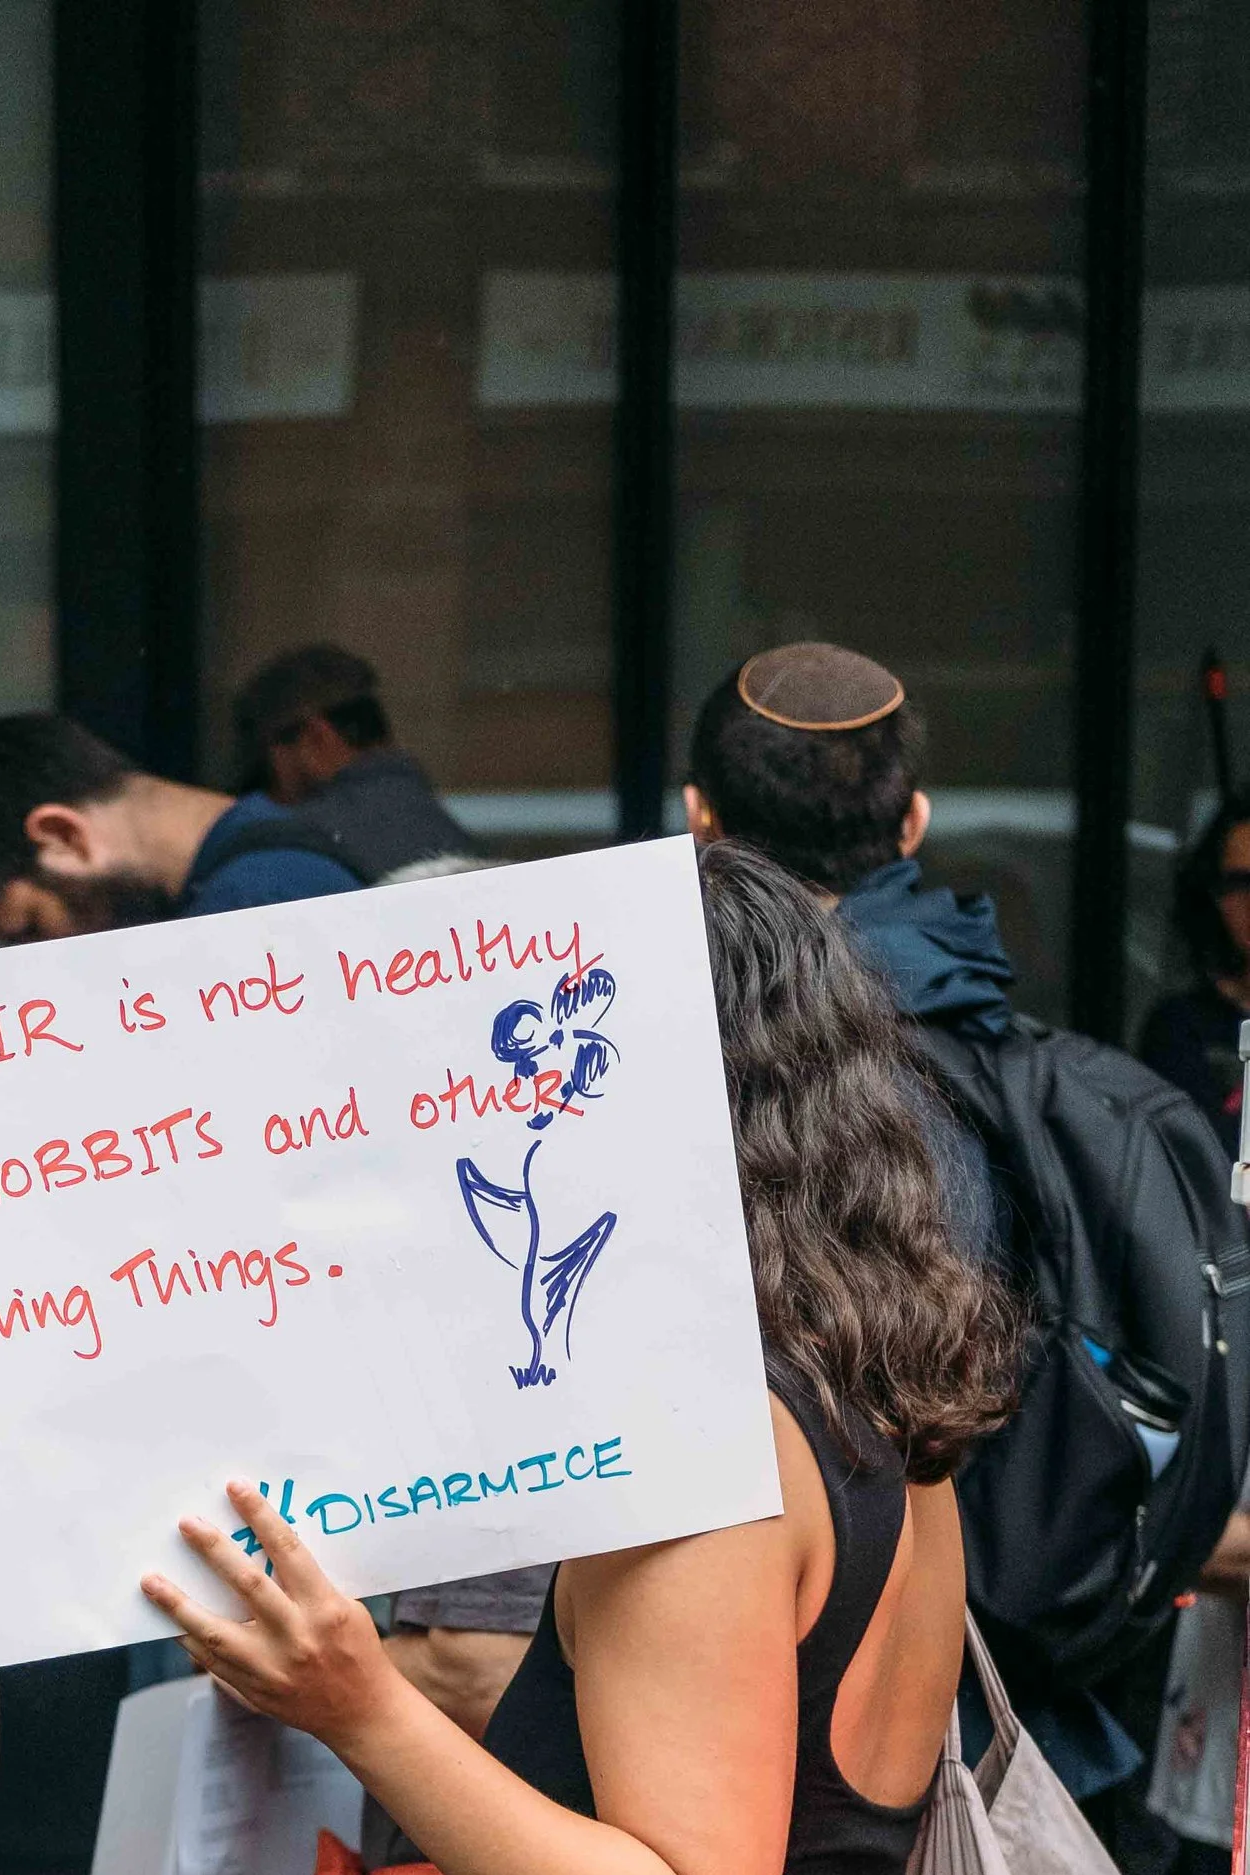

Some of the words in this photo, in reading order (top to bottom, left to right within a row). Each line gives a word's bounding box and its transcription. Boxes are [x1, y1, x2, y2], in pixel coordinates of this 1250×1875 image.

[119, 977, 167, 1034] is
[199, 952, 304, 1022] not
[338, 918, 605, 1001] healthy
[264, 1088, 368, 1155] and
[109, 1241, 344, 1328] Things.
